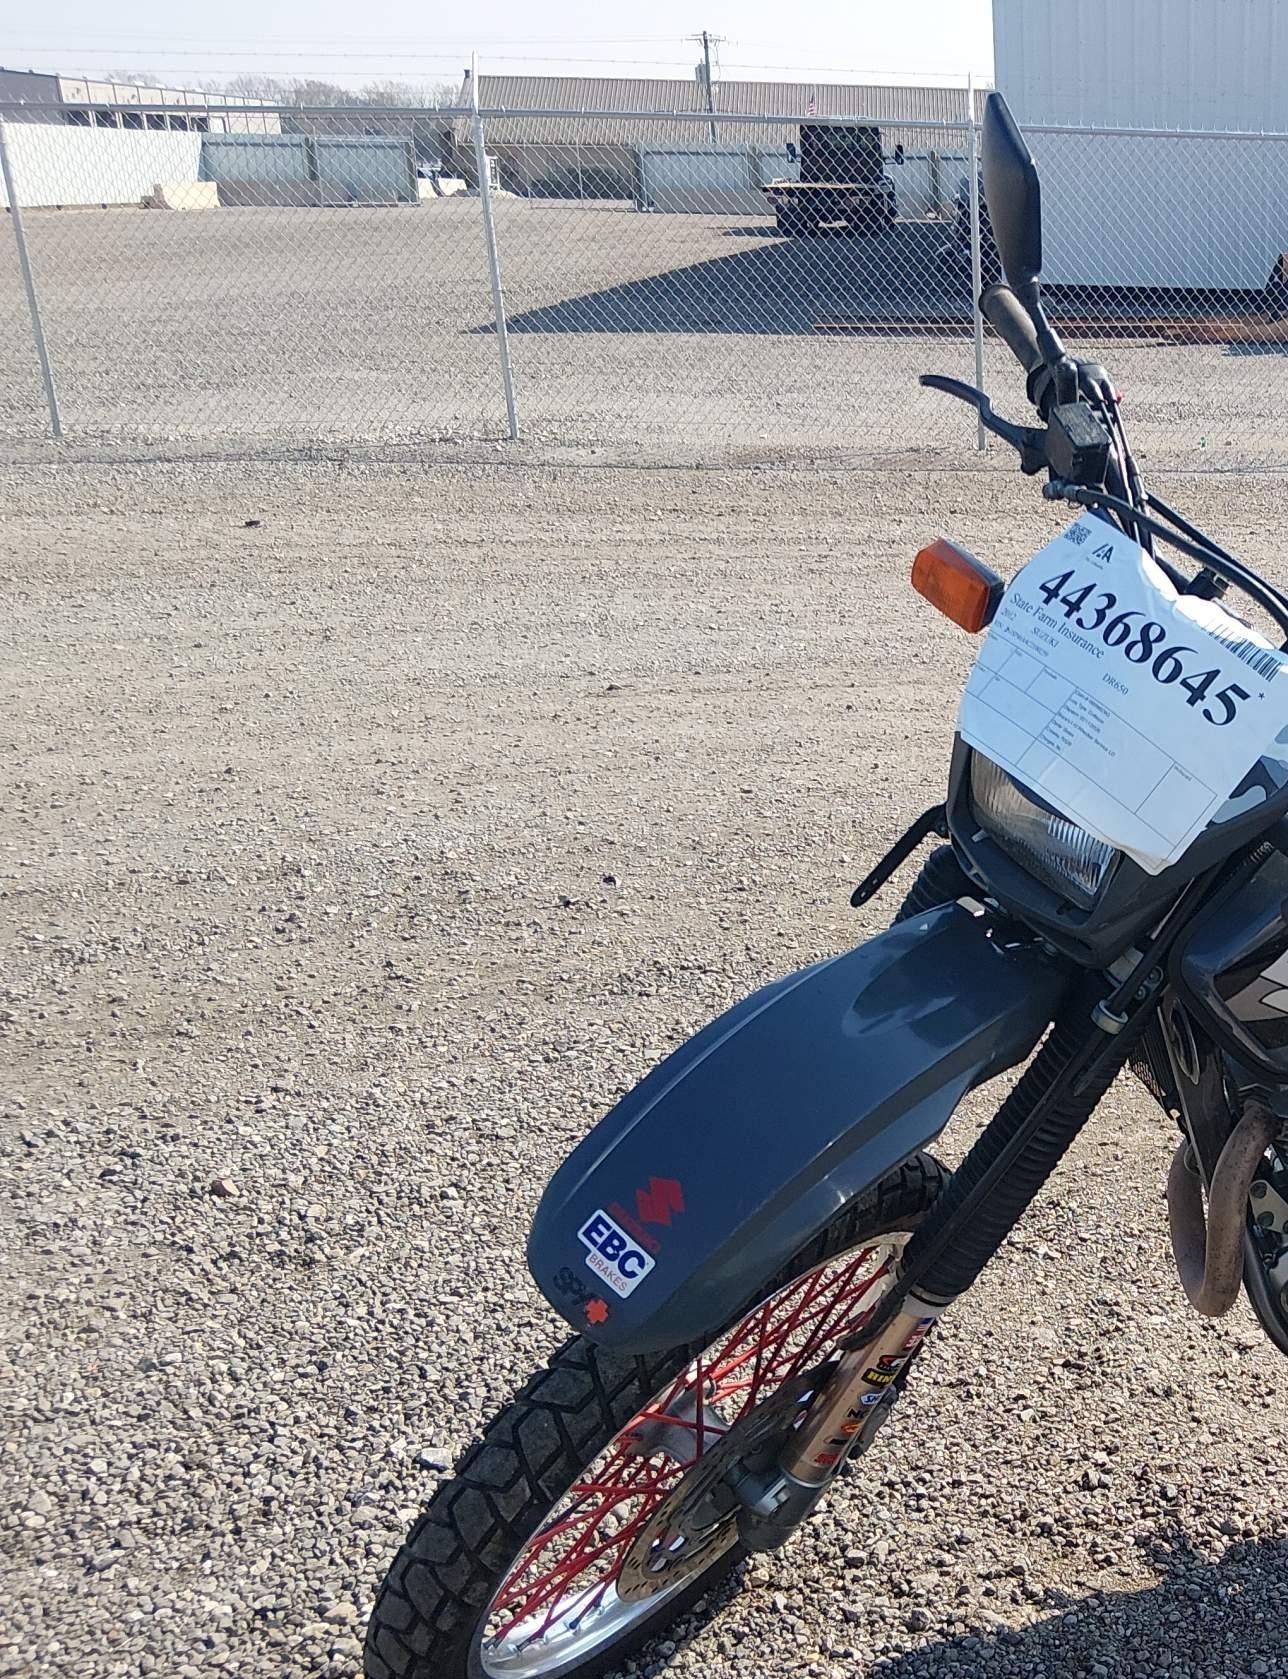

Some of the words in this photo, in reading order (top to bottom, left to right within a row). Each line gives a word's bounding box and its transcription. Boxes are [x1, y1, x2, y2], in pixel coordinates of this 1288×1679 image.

[1010, 593, 1034, 614] State
[1033, 605, 1058, 629] Farm
[1058, 622, 1105, 659] Insurance
[1039, 569, 1251, 726] 44368645
[1102, 672, 1129, 696] DR650
[582, 1214, 646, 1279] EBC
[589, 1253, 628, 1292] BRAKES
